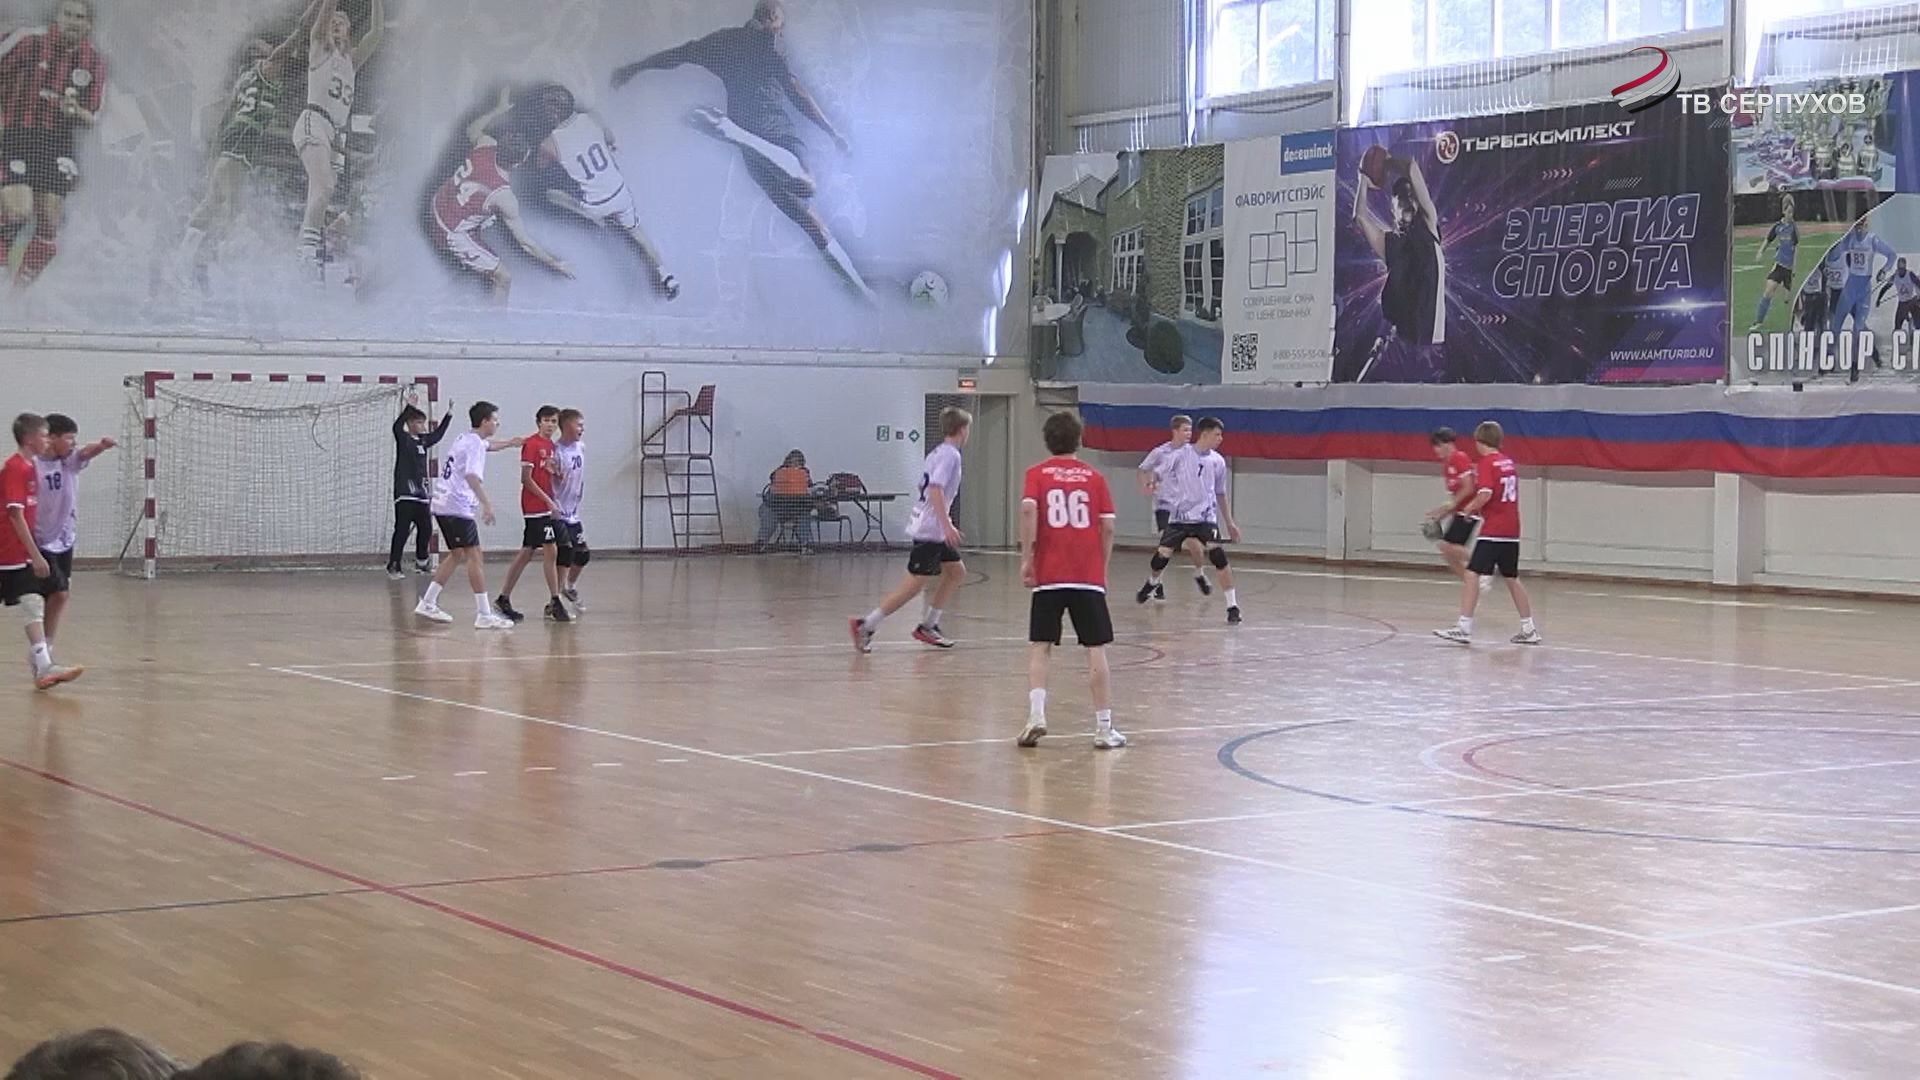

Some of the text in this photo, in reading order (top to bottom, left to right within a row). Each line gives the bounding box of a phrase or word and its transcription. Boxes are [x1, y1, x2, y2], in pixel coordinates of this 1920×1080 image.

[1461, 120, 1636, 152] ТУРБОКОМПЛЕКТ
[576, 143, 609, 181] 10
[1502, 193, 1700, 251] ЭНЕРГИЯ
[1493, 243, 1693, 298] СПОРТА
[45, 471, 62, 491] 18
[1046, 488, 1090, 529] 86
